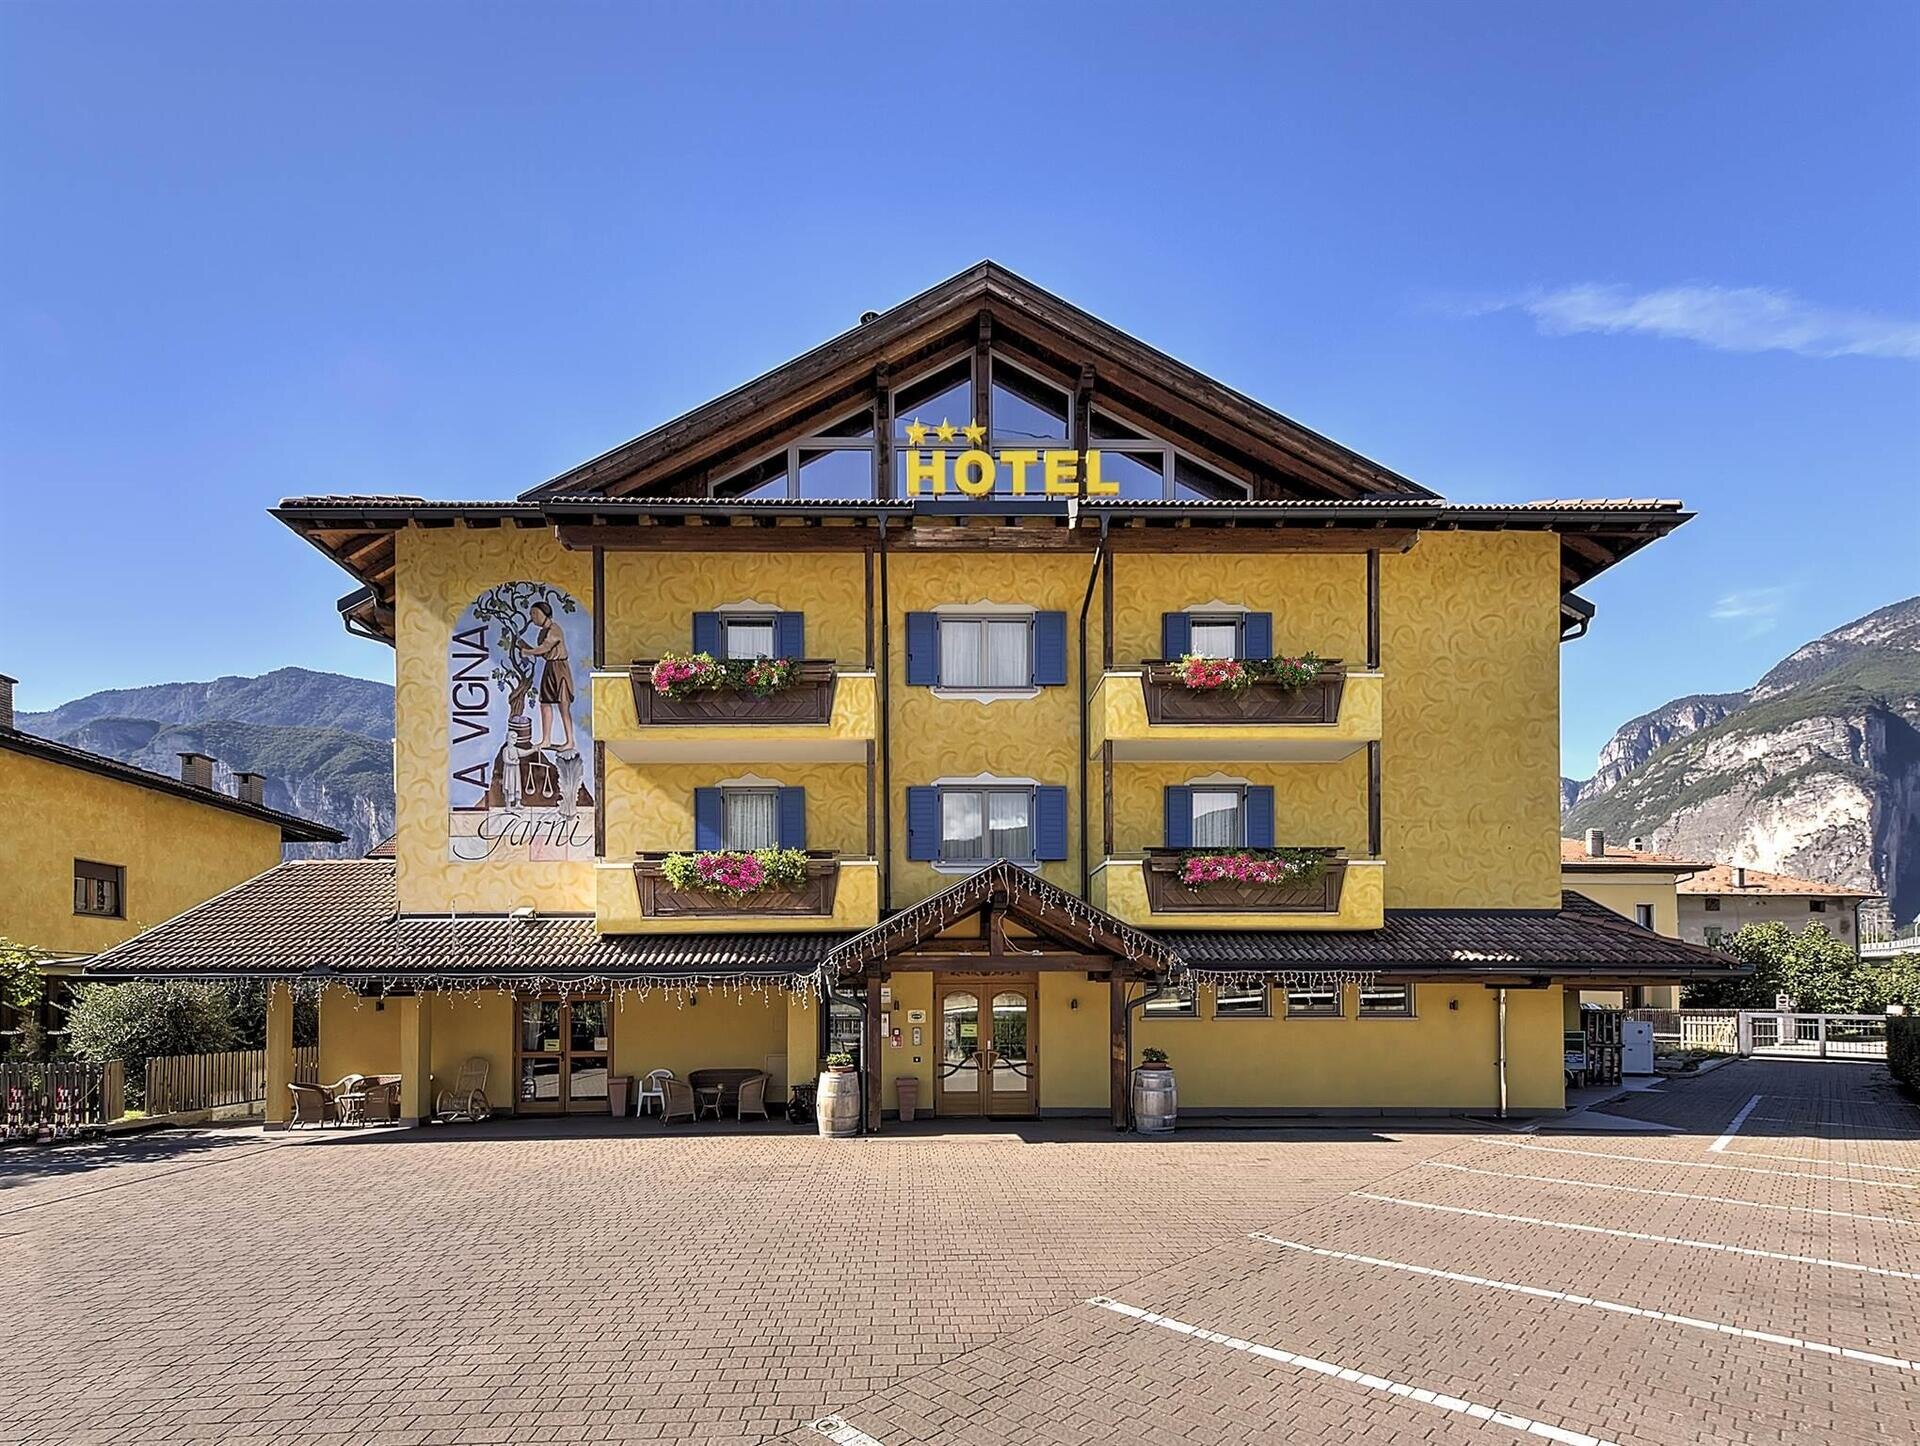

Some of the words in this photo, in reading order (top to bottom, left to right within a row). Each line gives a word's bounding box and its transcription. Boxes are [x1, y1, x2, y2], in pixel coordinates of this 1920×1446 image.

[906, 449, 1120, 496] HOTEL
[452, 625, 489, 744] VIGNA
[452, 762, 489, 812] LA
